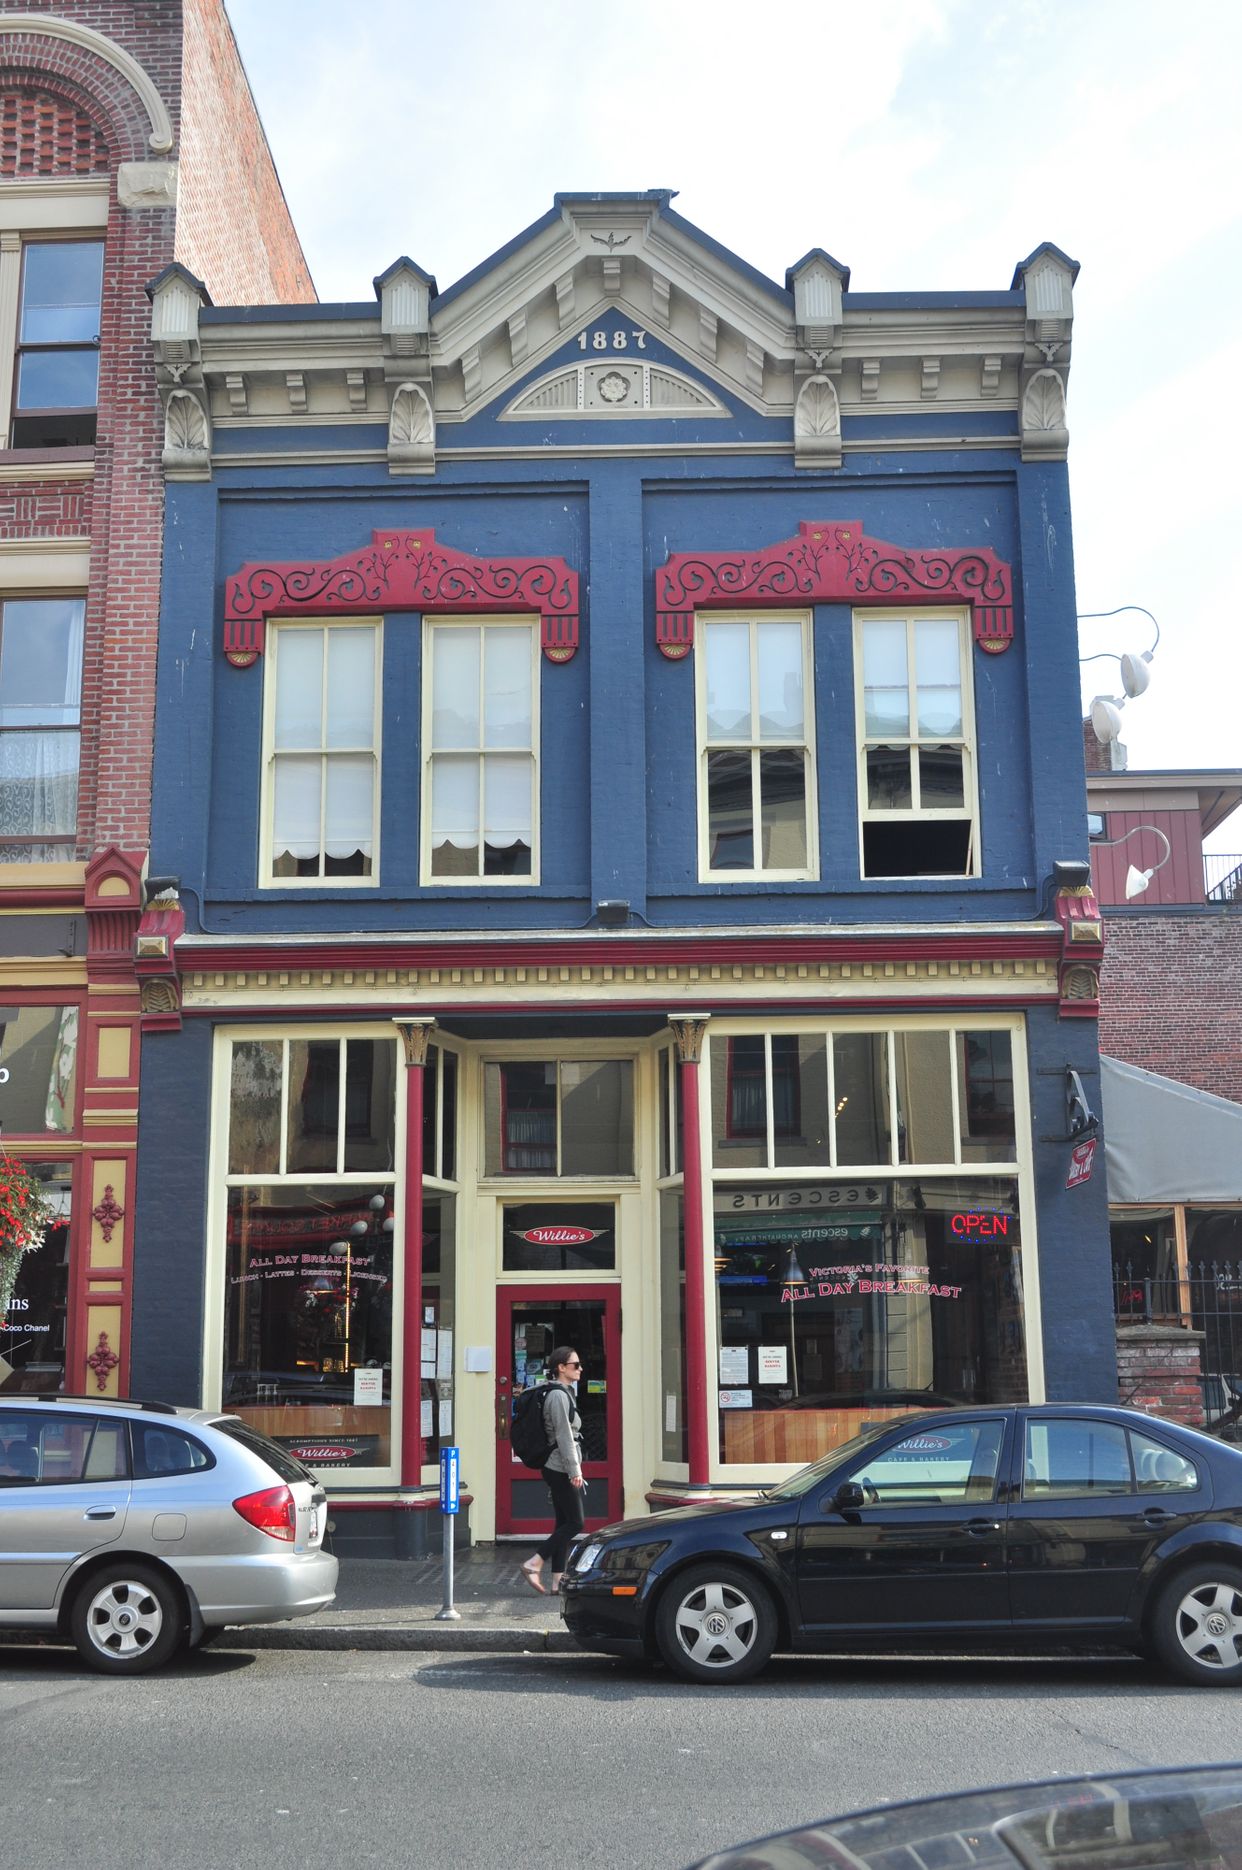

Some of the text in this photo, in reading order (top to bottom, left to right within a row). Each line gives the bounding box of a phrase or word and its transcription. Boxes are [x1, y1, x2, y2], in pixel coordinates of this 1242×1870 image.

[577, 331, 646, 350] 1887
[951, 1214, 1008, 1235] OPEN
[533, 1230, 586, 1241] Willie's
[249, 1253, 369, 1268] ALL DAY BREAKFAST
[265, 1269, 295, 1279] LATTES
[808, 1263, 930, 1278] VICTORIA'S FAVORITE
[780, 1279, 962, 1303] ALL DAY BREAKFAST
[24, 1323, 50, 1332] Chanel
[297, 1448, 347, 1457] Willie's
